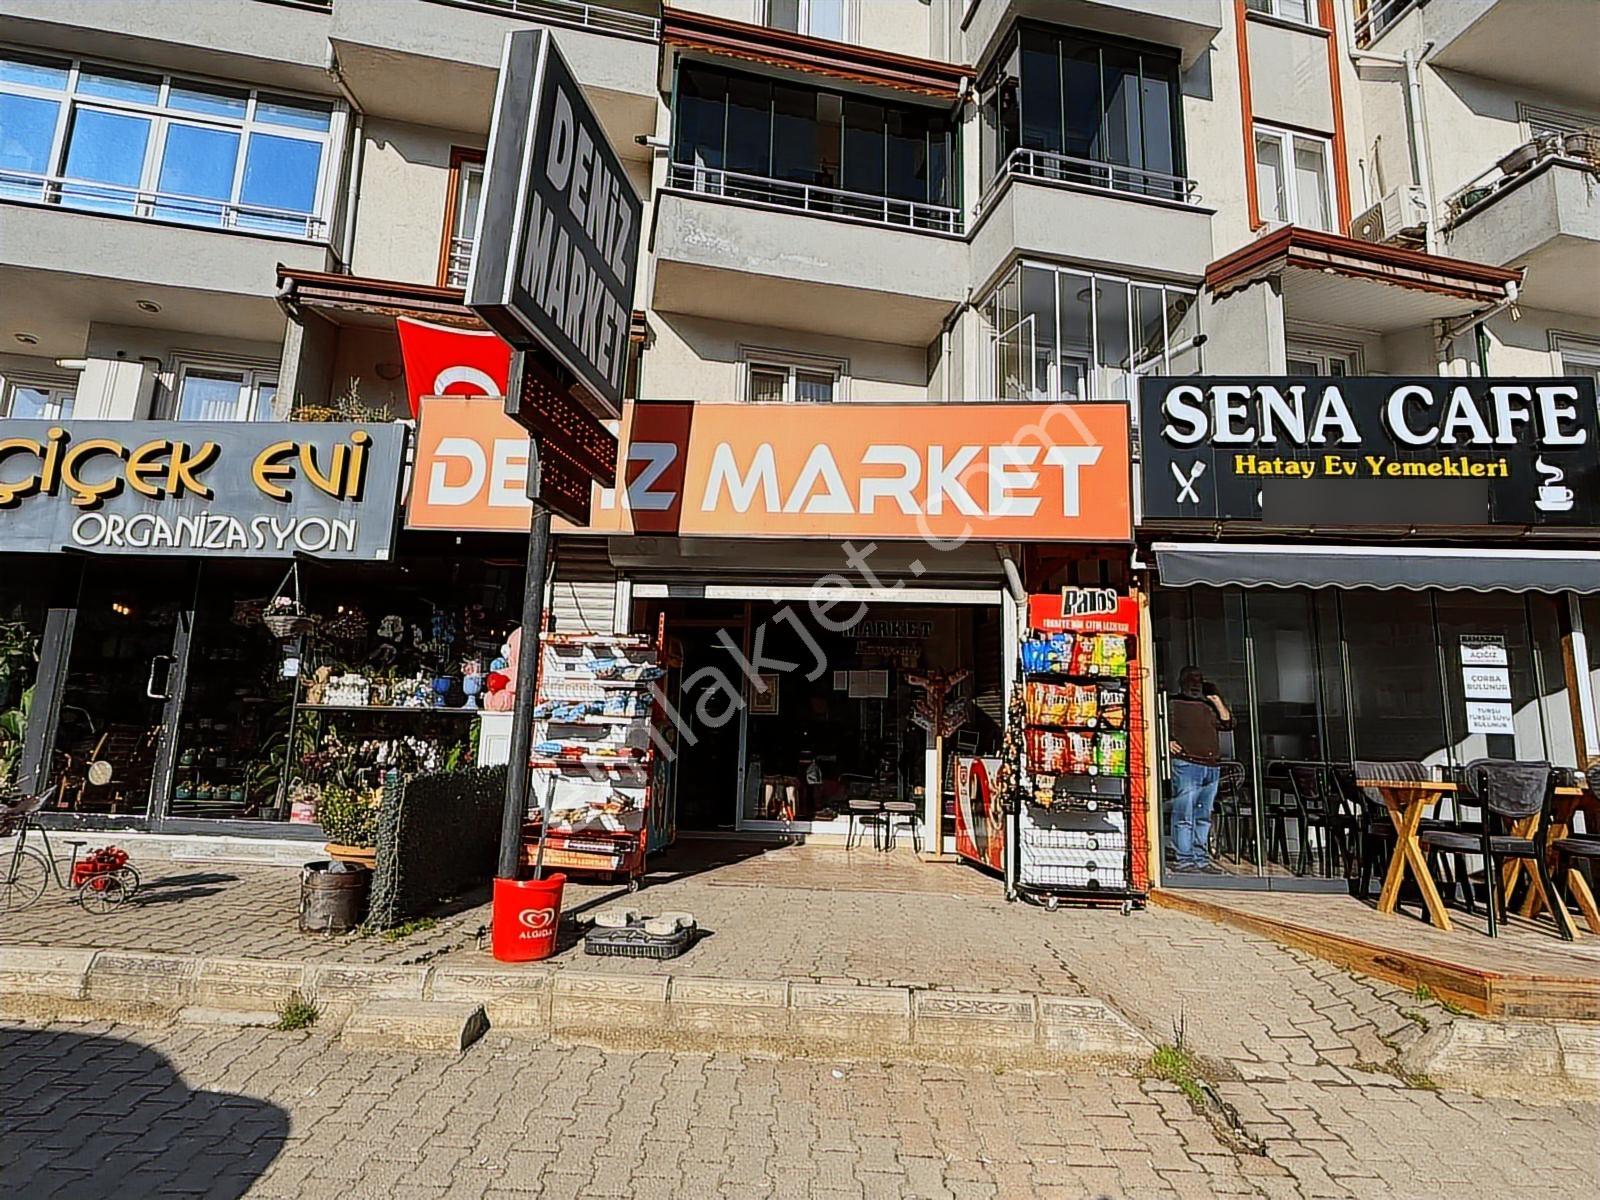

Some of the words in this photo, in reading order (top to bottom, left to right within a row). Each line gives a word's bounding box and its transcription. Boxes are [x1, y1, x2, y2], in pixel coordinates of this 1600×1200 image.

[546, 84, 633, 288] DENİZ
[521, 189, 627, 390] MARKET
[1164, 385, 1362, 446] SENA
[1385, 385, 1588, 446] CAFE
[0, 427, 219, 507] ÇİÇEK
[252, 429, 371, 499] EVİ
[427, 421, 678, 511] DEZ
[701, 442, 1104, 517] MARKET
[1234, 454, 1315, 479] Hatay
[1324, 455, 1357, 476] Ev
[1365, 455, 1509, 478] Yemekleri
[71, 510, 357, 551] ORGANİZASYON
